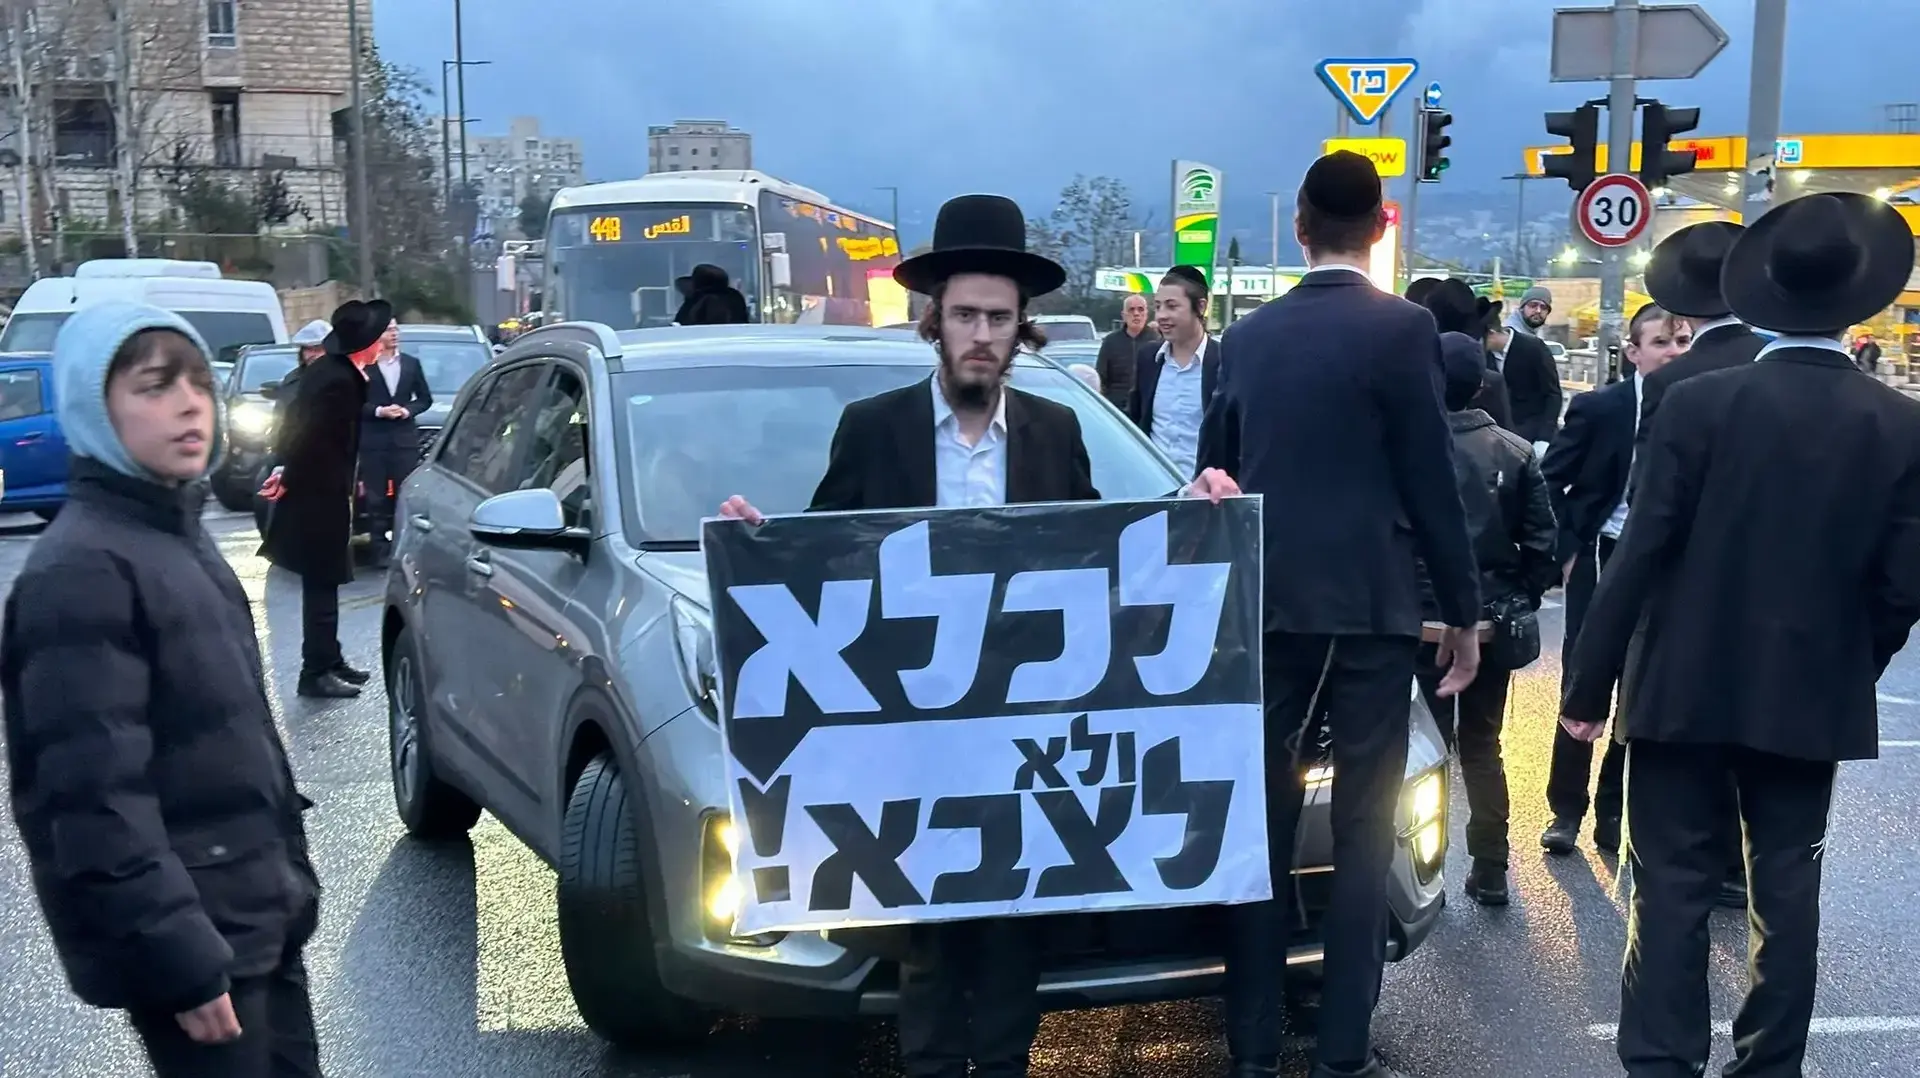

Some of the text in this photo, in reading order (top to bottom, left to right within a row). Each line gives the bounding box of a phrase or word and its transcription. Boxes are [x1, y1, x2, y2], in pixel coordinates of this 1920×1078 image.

[1349, 69, 1386, 94] פז
[644, 215, 690, 239] القدس
[1594, 196, 1637, 227] 30
[1239, 278, 1268, 290] דור
[727, 510, 1232, 720] לכלא
[1011, 713, 1137, 791] ולא
[737, 735, 1236, 912] לצבא!
